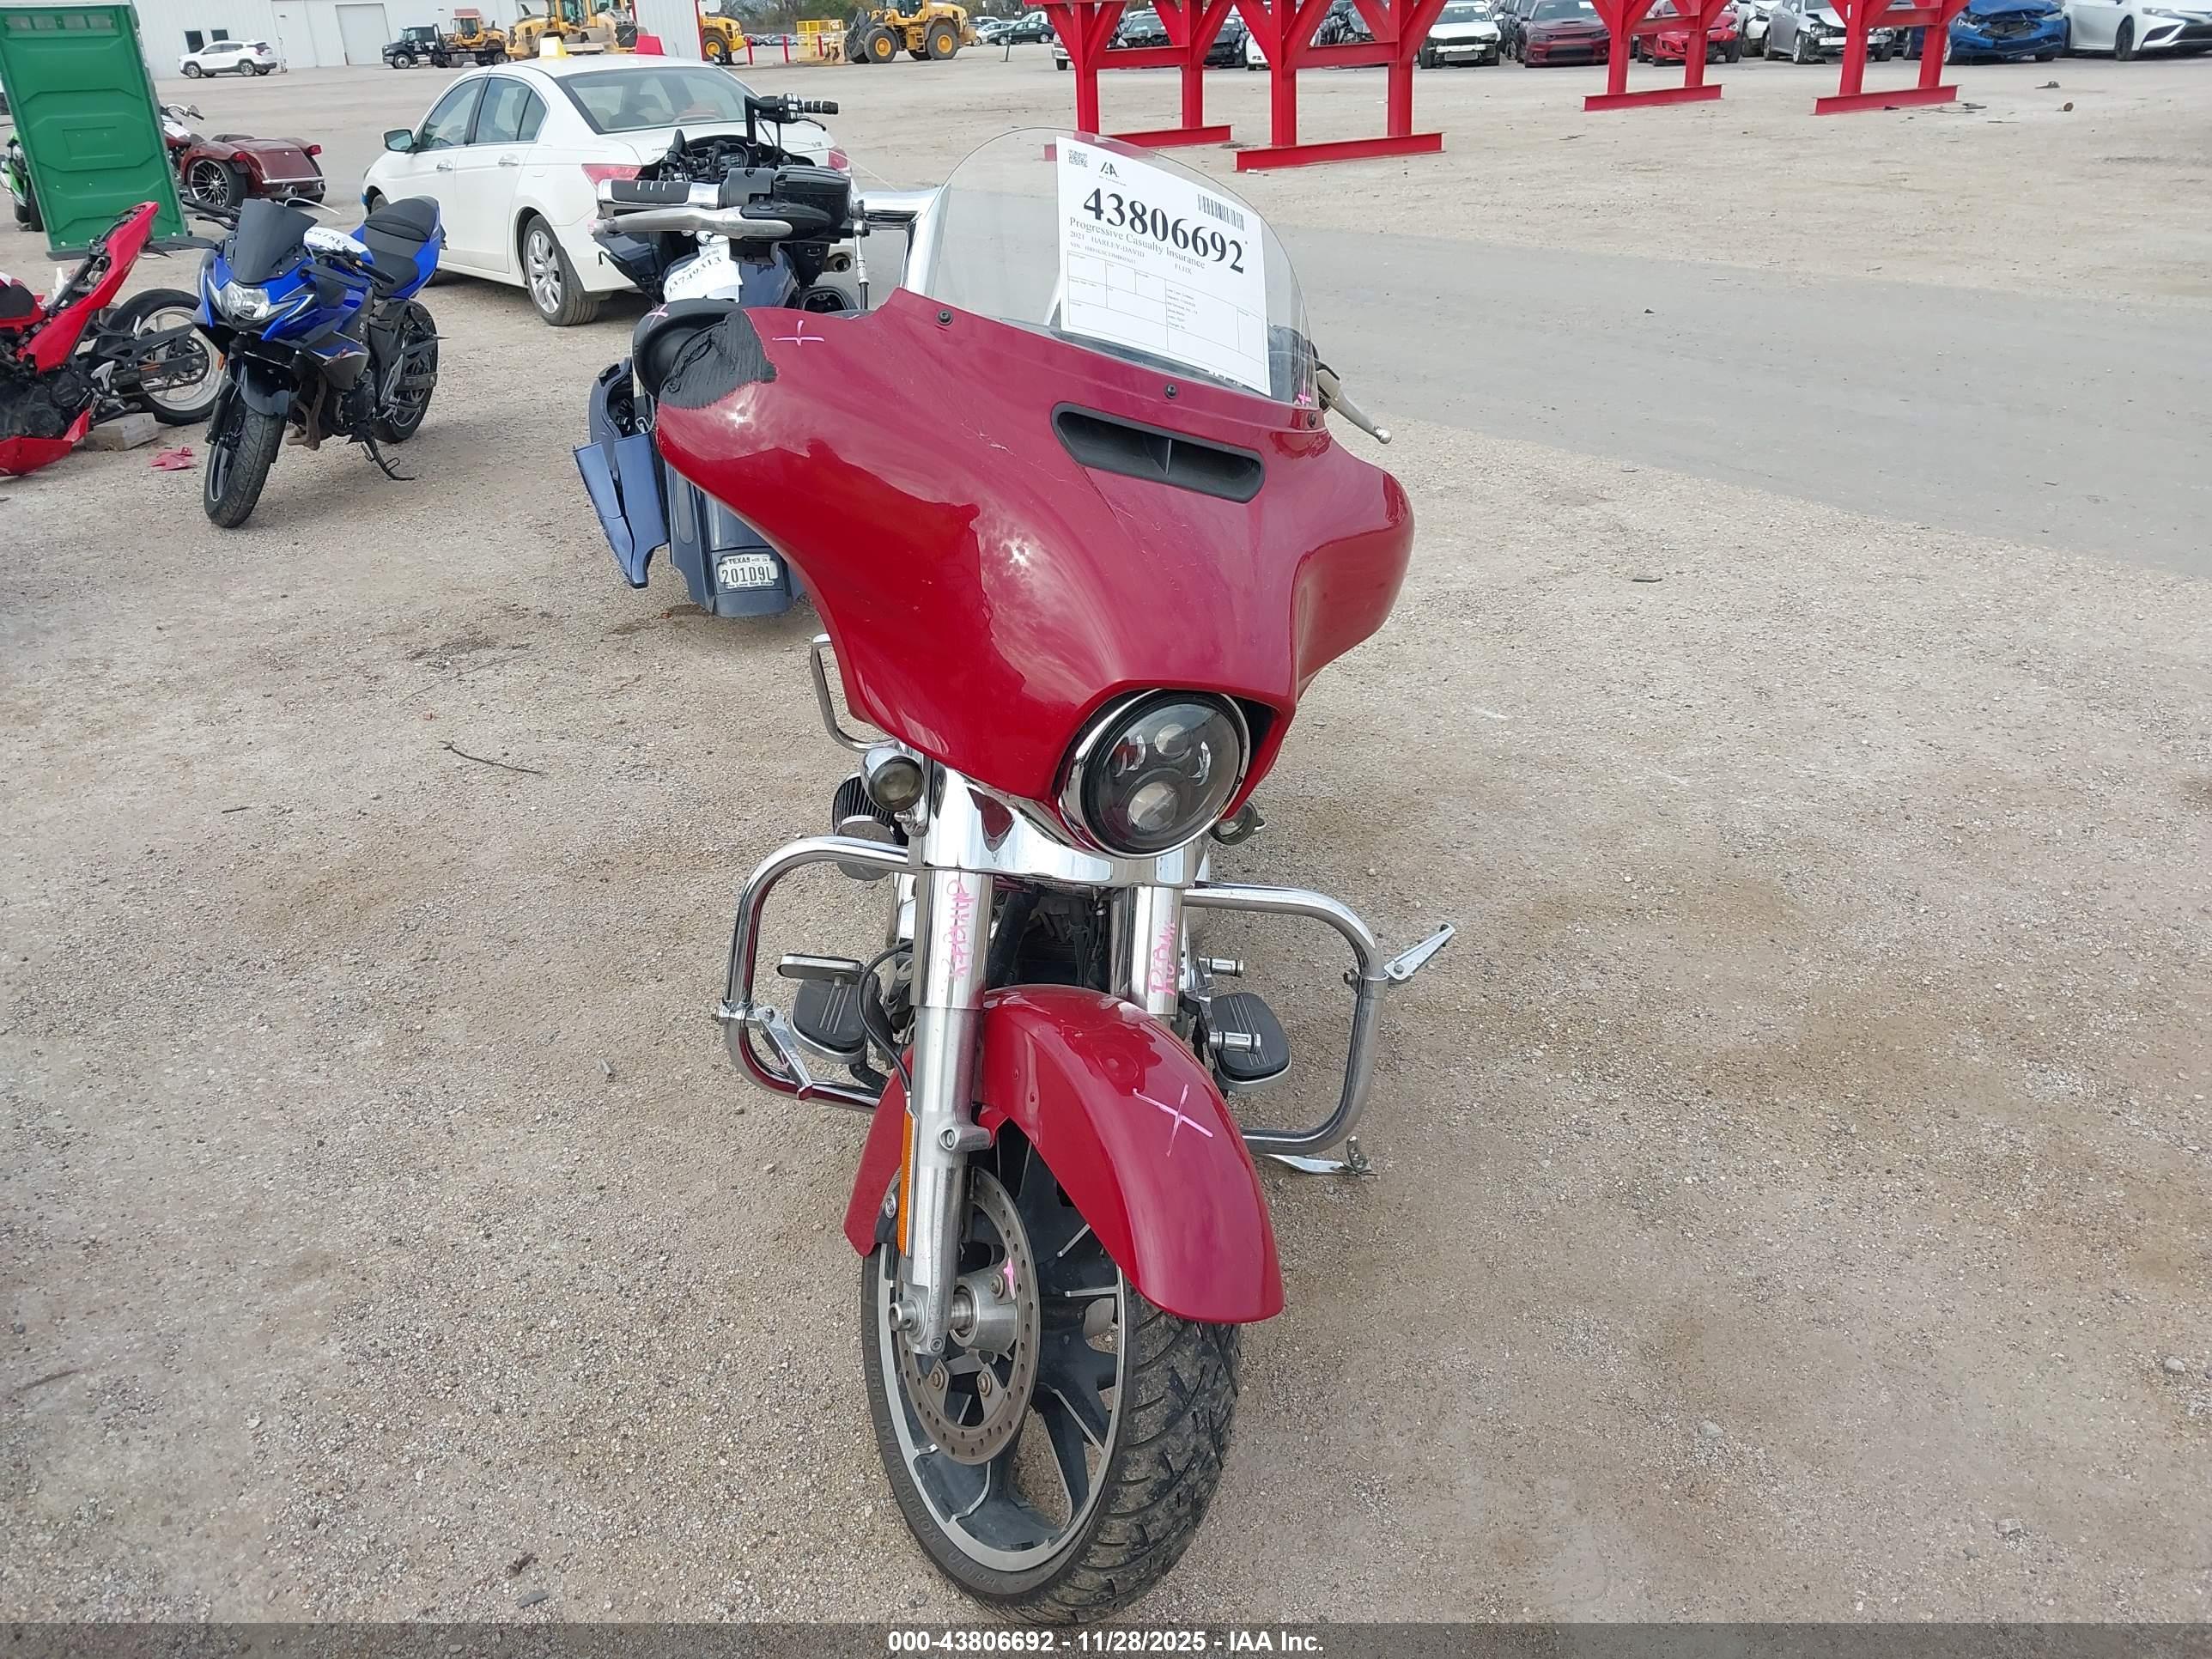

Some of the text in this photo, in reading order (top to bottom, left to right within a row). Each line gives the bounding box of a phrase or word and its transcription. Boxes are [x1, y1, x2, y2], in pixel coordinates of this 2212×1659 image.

[1069, 230, 1085, 240] 2021
[1069, 216, 1124, 240] Progressive
[1126, 234, 1164, 256] Casualty
[1166, 246, 1206, 270] Insurance
[1084, 187, 1244, 275] 43806692
[879, 1419, 943, 1545] MARATHON
[947, 1549, 997, 1588] ULTRA
